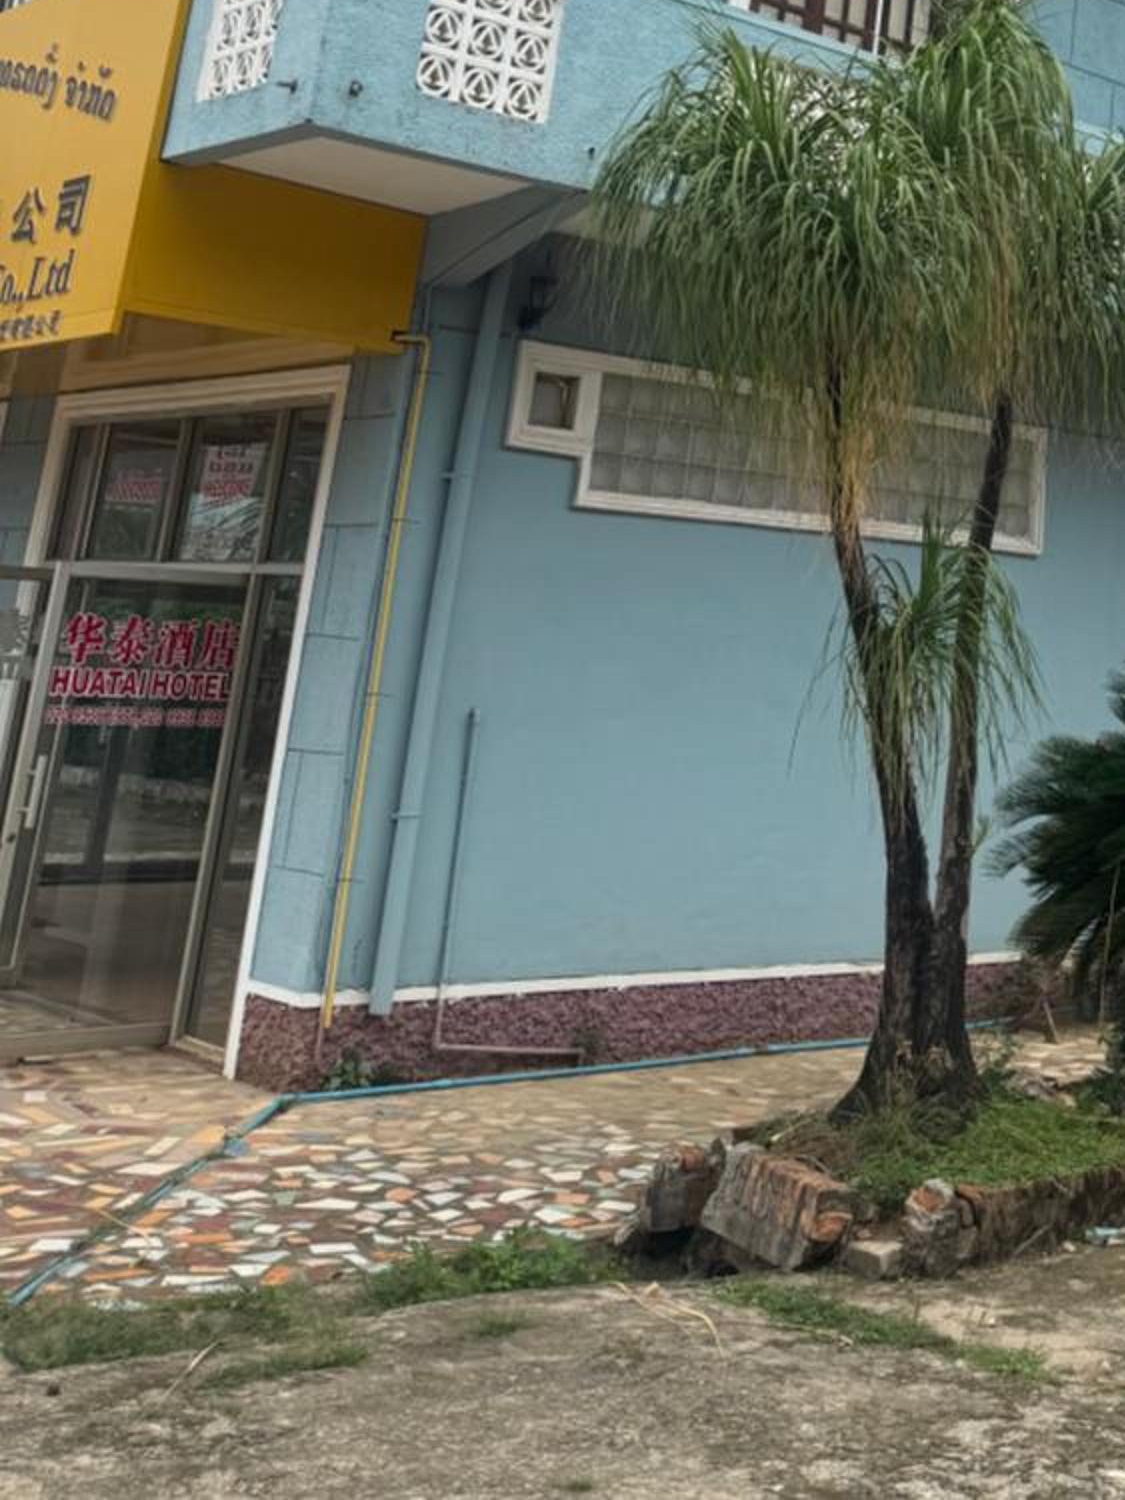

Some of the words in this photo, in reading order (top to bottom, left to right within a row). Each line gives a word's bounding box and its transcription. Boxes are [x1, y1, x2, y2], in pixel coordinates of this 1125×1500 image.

[11, 174, 91, 245] 公司
[0, 248, 75, 310] o.,Ltd
[63, 612, 239, 669] 华泰酒店
[50, 666, 148, 699] HUATAI
[150, 669, 231, 701] HOTEL
